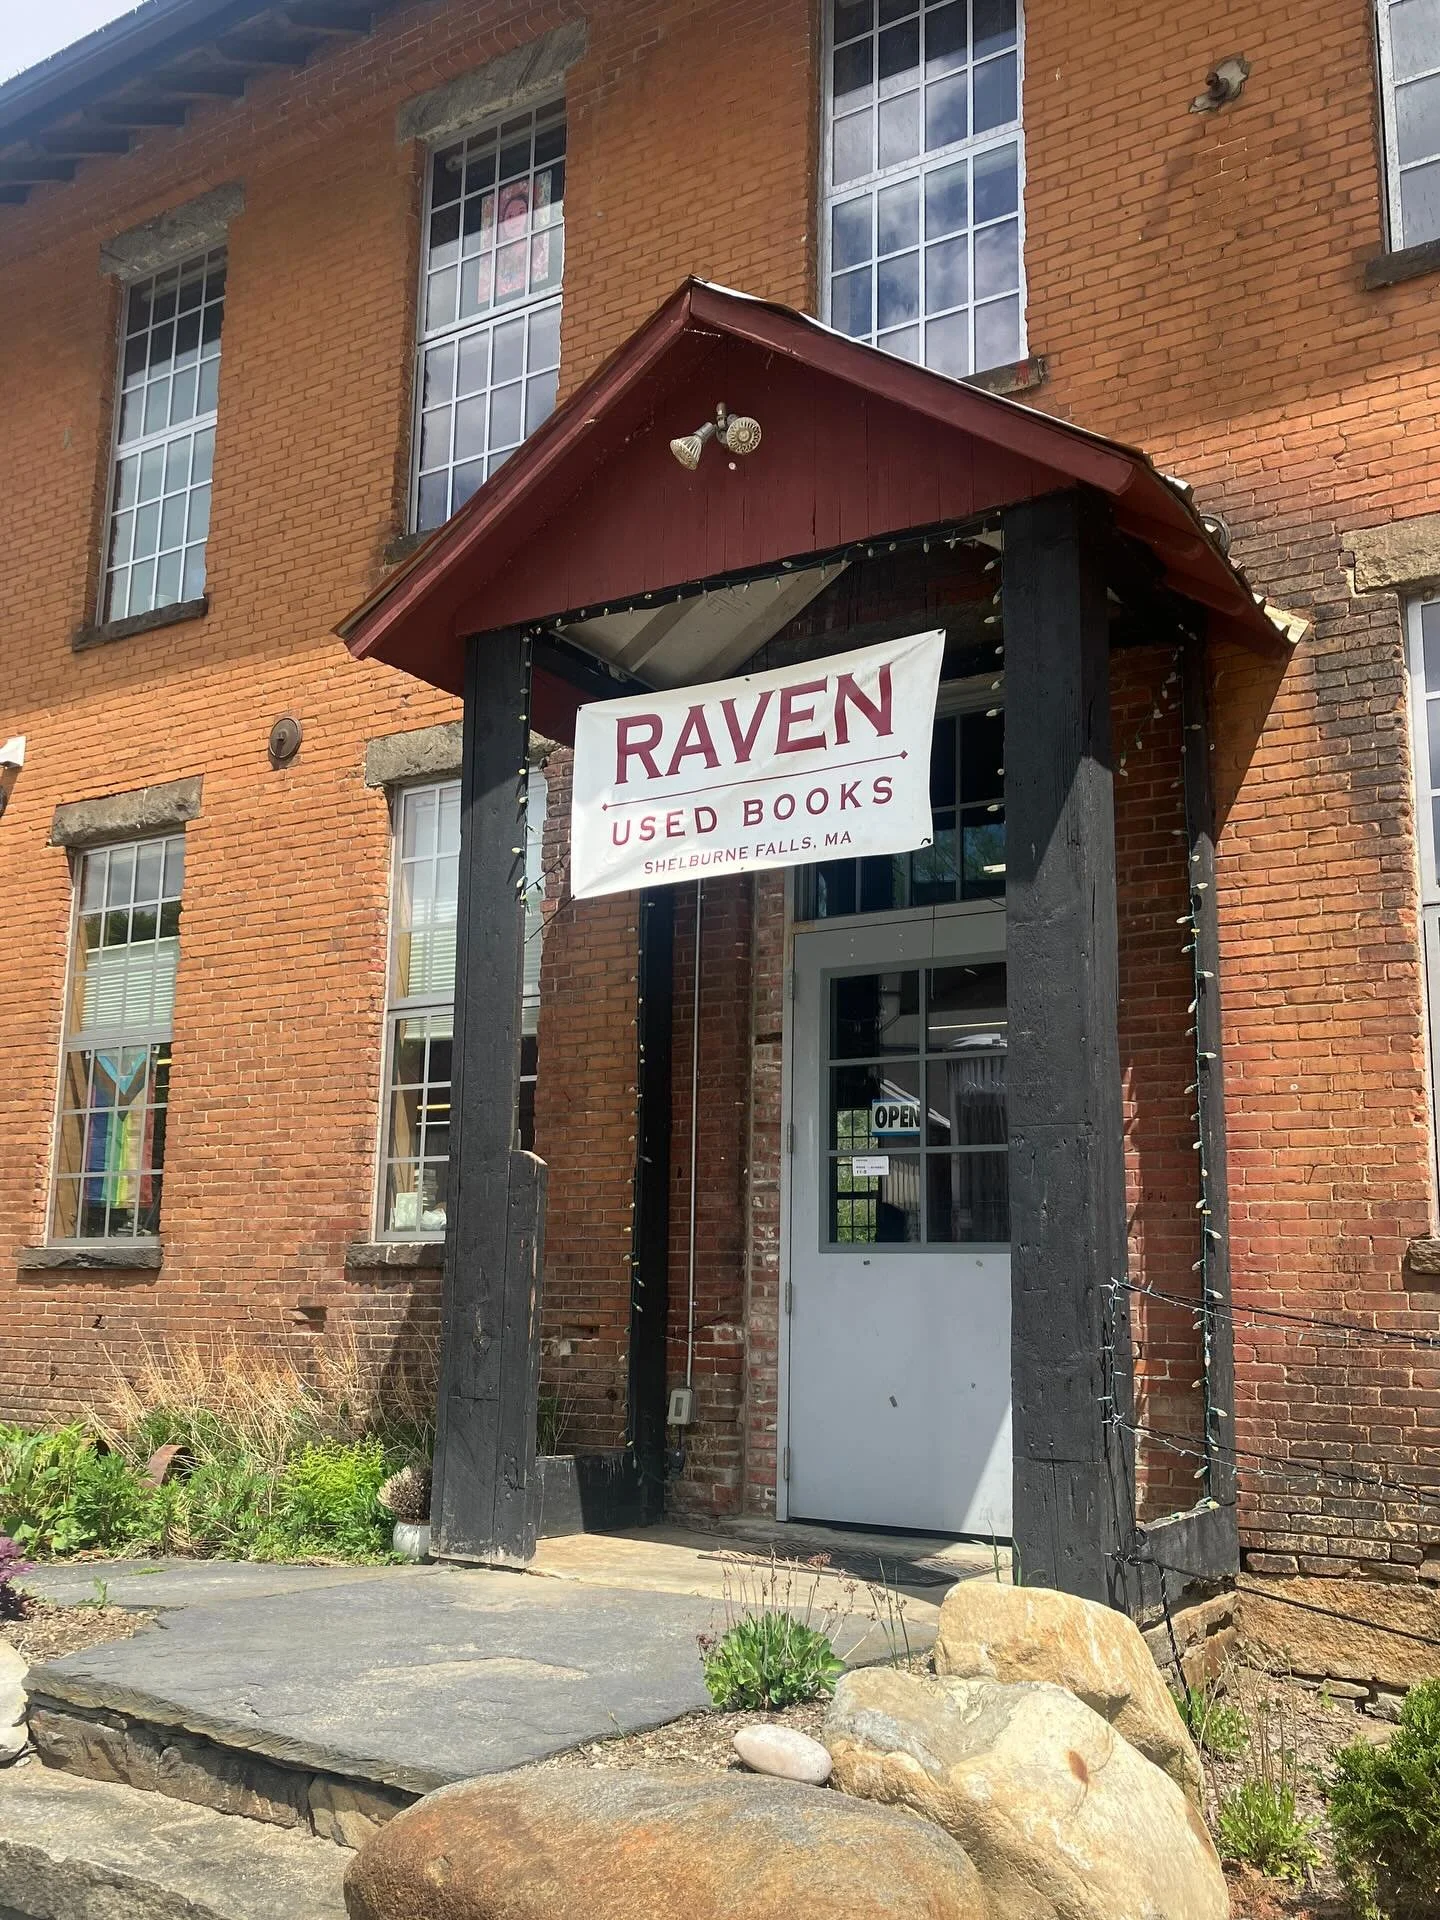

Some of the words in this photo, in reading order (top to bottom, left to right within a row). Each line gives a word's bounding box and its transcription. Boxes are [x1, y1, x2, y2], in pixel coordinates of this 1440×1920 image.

[615, 662, 894, 784] RAVEN
[612, 806, 718, 846] USED
[743, 776, 893, 826] BOOKS
[644, 846, 749, 874] SHELBURNE
[824, 831, 852, 847] MA
[874, 1105, 920, 1128] OPEN
